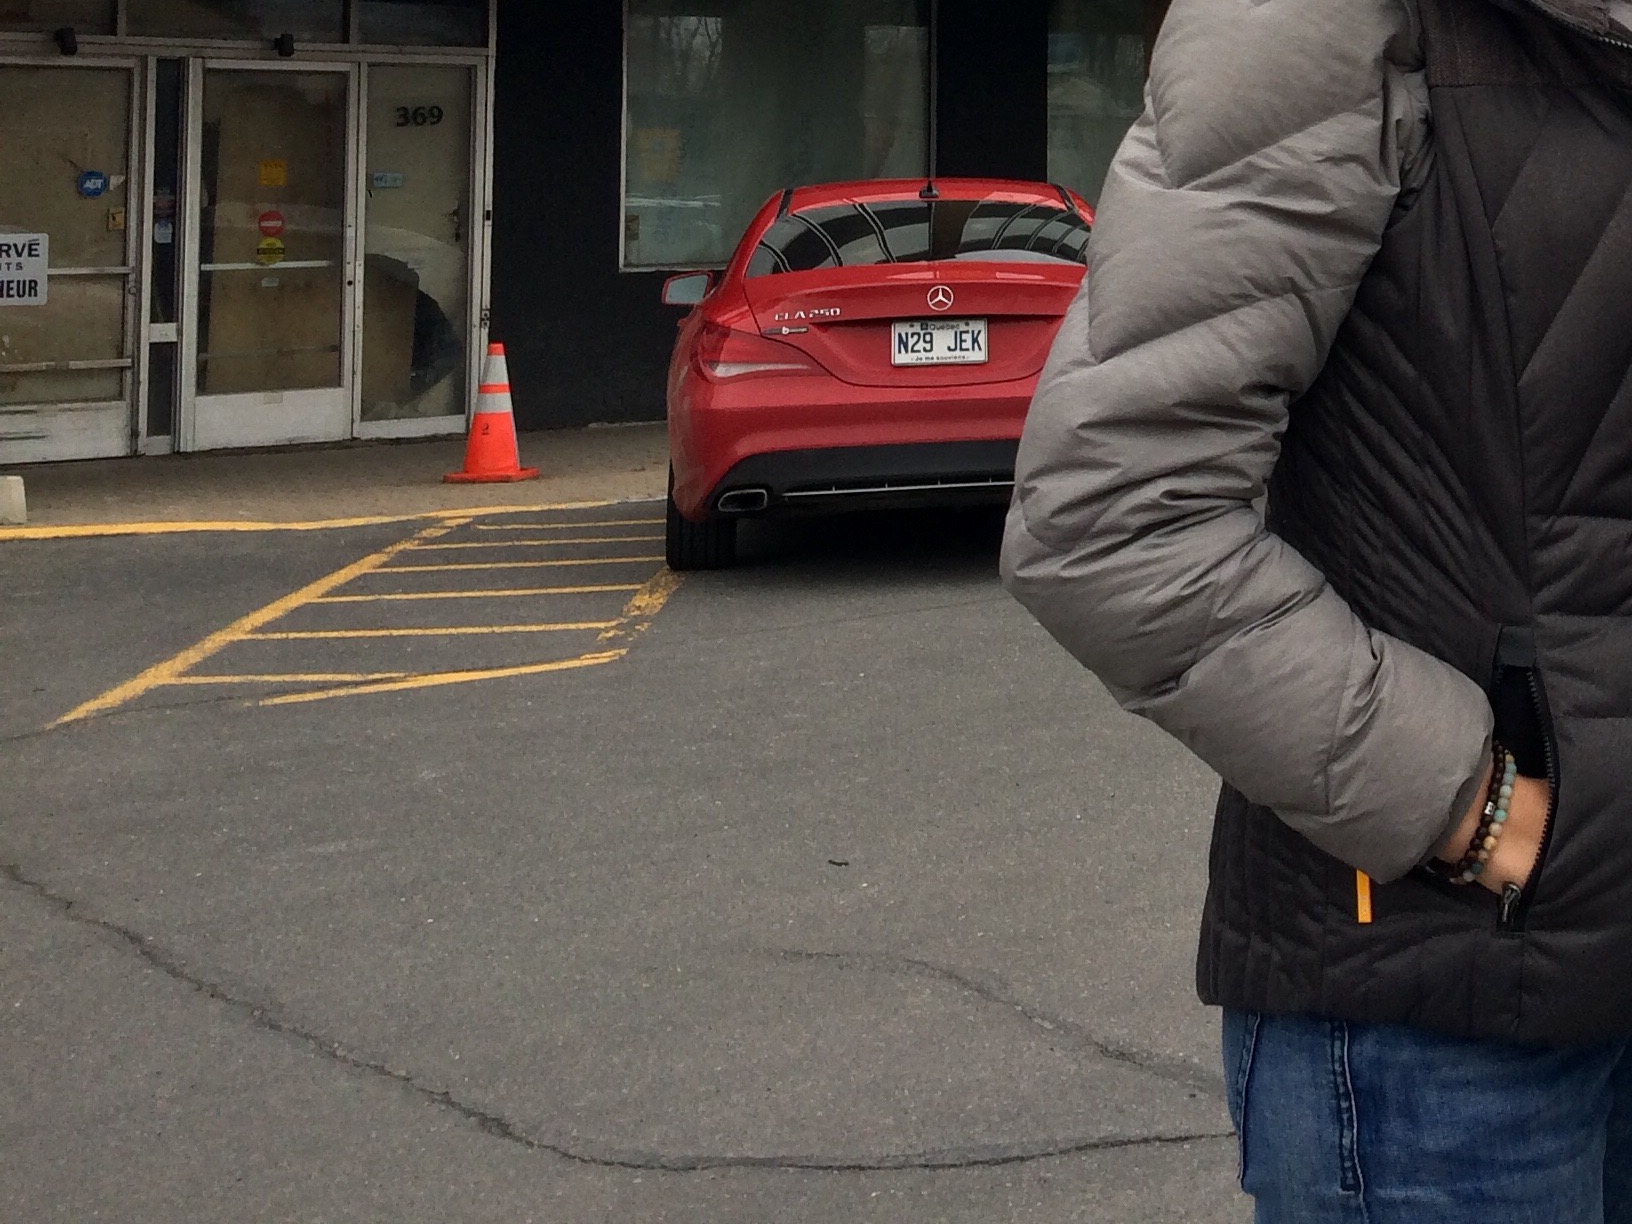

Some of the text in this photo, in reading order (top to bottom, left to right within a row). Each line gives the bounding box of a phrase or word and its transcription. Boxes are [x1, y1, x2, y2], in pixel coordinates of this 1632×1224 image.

[396, 105, 443, 127] 369
[897, 329, 983, 354] N29 JEK
